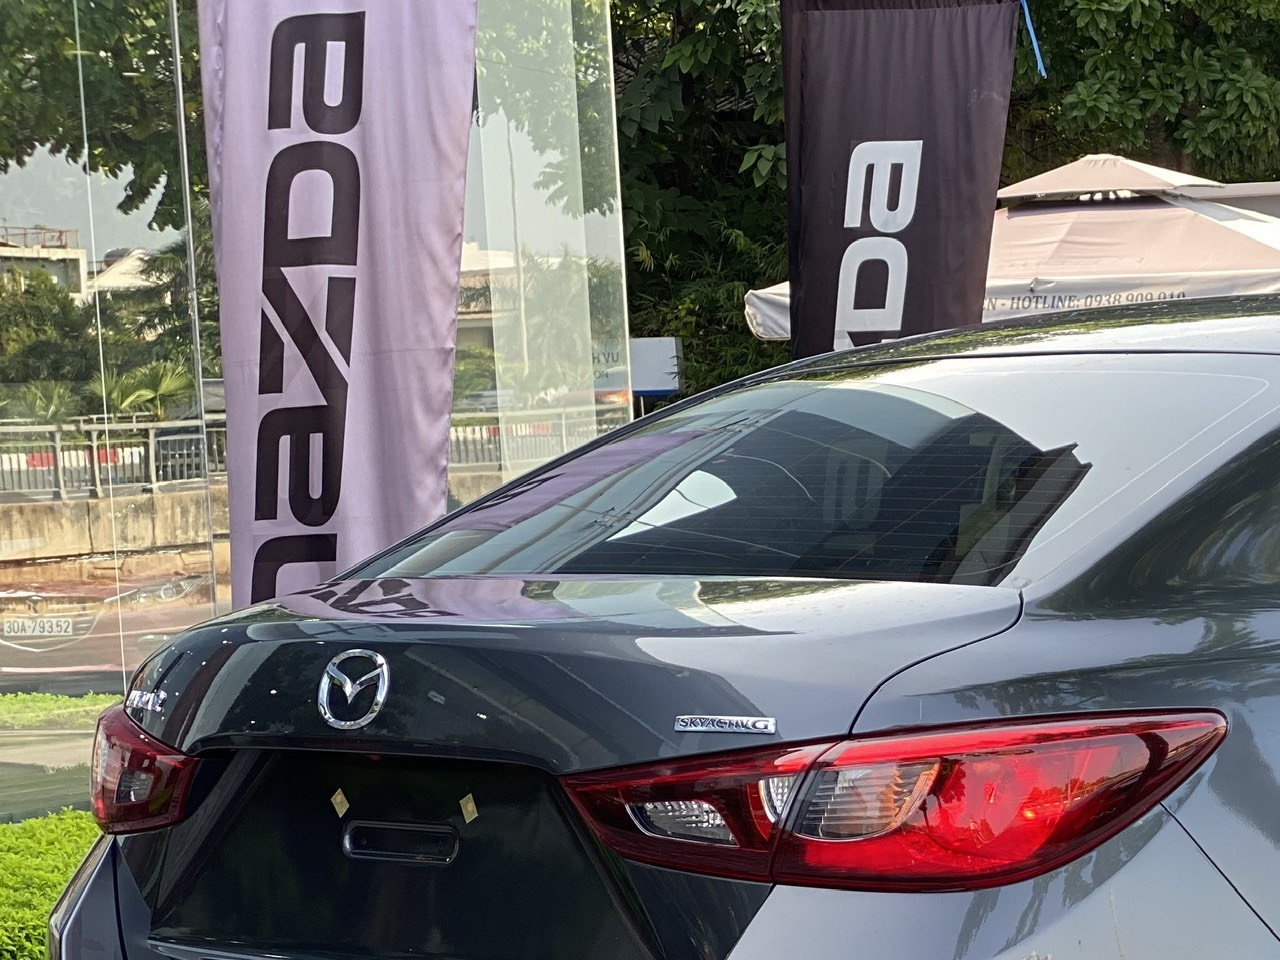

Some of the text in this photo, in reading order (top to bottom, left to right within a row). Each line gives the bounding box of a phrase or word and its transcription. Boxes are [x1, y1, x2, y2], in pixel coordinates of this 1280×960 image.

[1010, 295, 1080, 310] HOTLINE:
[1084, 293, 1122, 307] 0938
[5, 619, 71, 634] 30A-793.52
